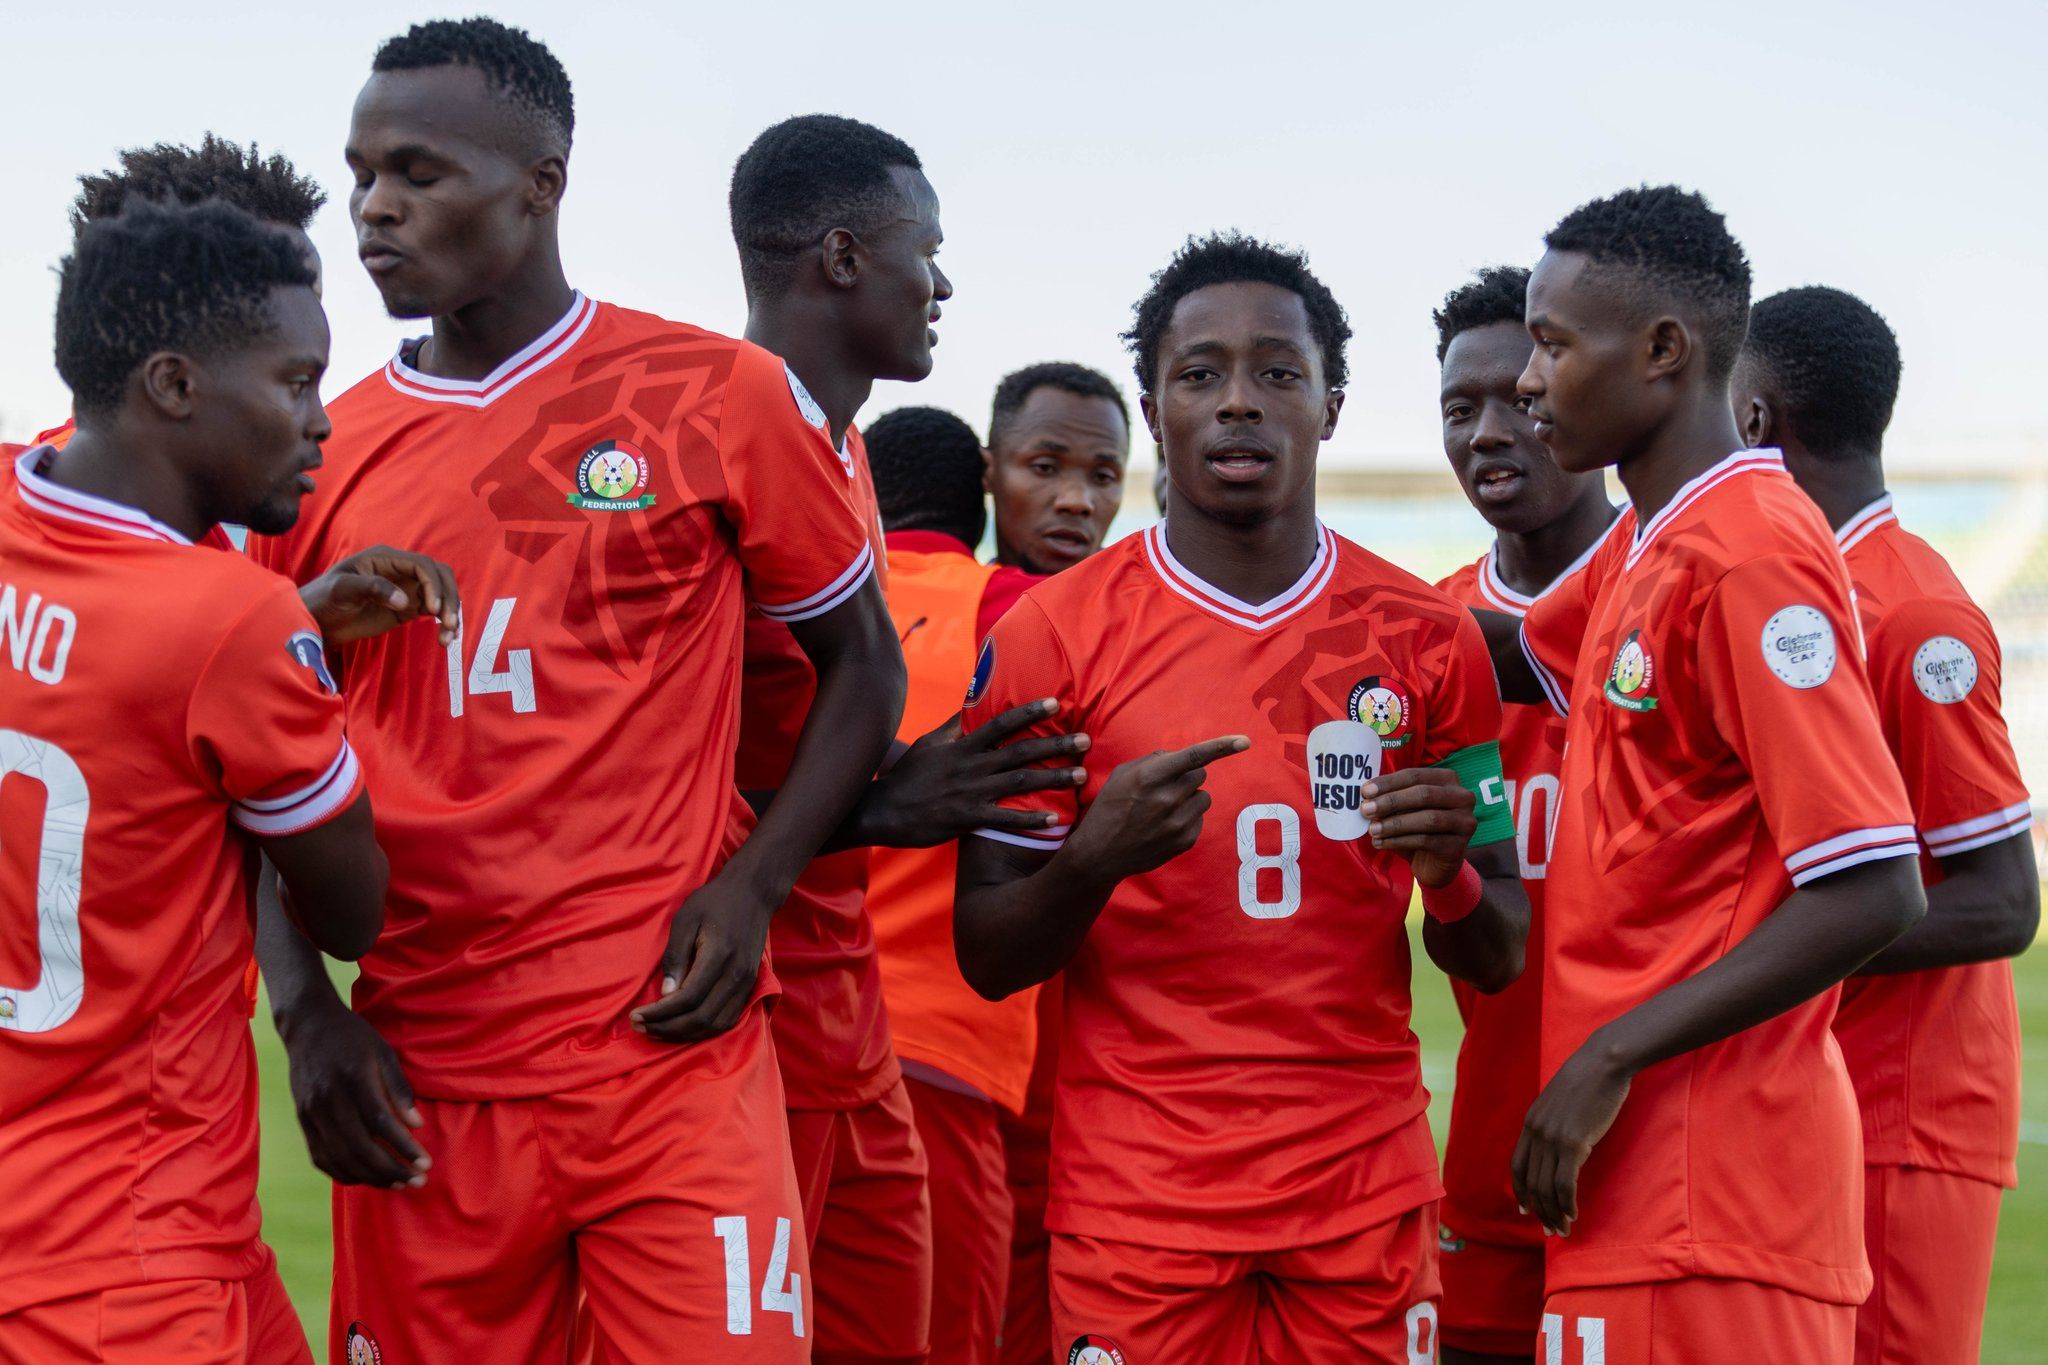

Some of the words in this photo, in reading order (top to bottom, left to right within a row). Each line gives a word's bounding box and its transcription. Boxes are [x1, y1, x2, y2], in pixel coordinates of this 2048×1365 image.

[579, 449, 599, 493] FOOTBALL
[638, 457, 647, 488] KENYA
[582, 500, 640, 510] FEDERATION
[0, 583, 77, 685] NO
[434, 597, 537, 718] 14
[1790, 651, 1816, 664] CAF
[1350, 685, 1366, 722] OOTBALL
[1401, 695, 1409, 726] KENYA
[1381, 740, 1402, 748] ATION
[1315, 752, 1373, 780] 100%
[1313, 783, 1364, 811] JESU
[1479, 776, 1507, 805] C
[1236, 803, 1302, 919] 8
[713, 1215, 805, 1338] 14
